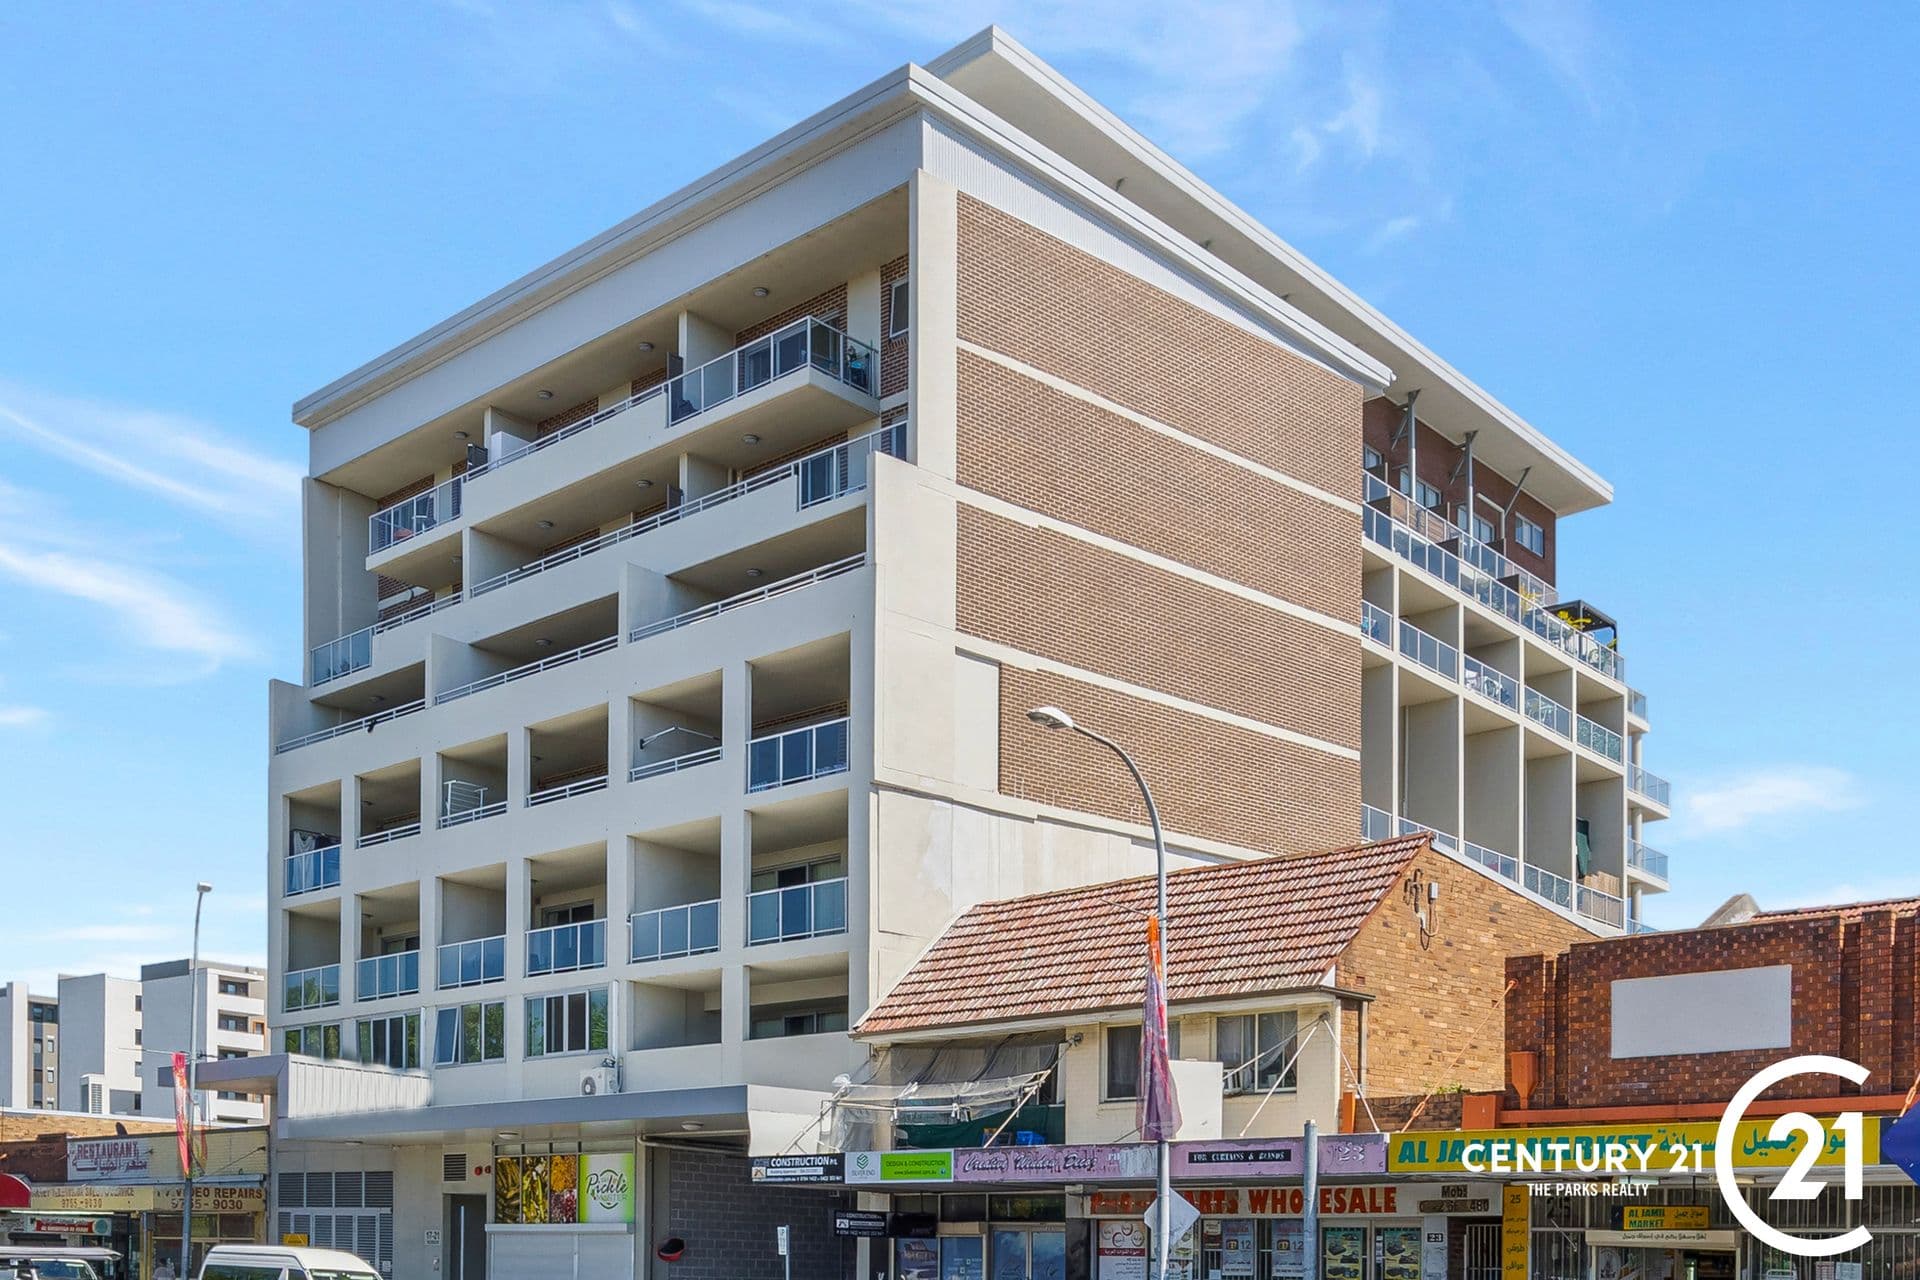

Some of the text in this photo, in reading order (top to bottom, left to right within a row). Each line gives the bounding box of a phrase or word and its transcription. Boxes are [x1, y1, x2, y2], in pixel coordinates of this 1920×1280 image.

[77, 1141, 138, 1159] RESTAURANT
[1398, 1140, 1429, 1163] AL
[771, 1156, 829, 1167] CONSTRUCTION
[1193, 1153, 1207, 1161] FOR
[214, 1187, 264, 1199] REPAIRS
[1248, 1187, 1397, 1213] WHOESALE
[1628, 1209, 1639, 1217] AL
[1629, 1219, 1664, 1228] MARKET
[1429, 1234, 1443, 1242] 23
